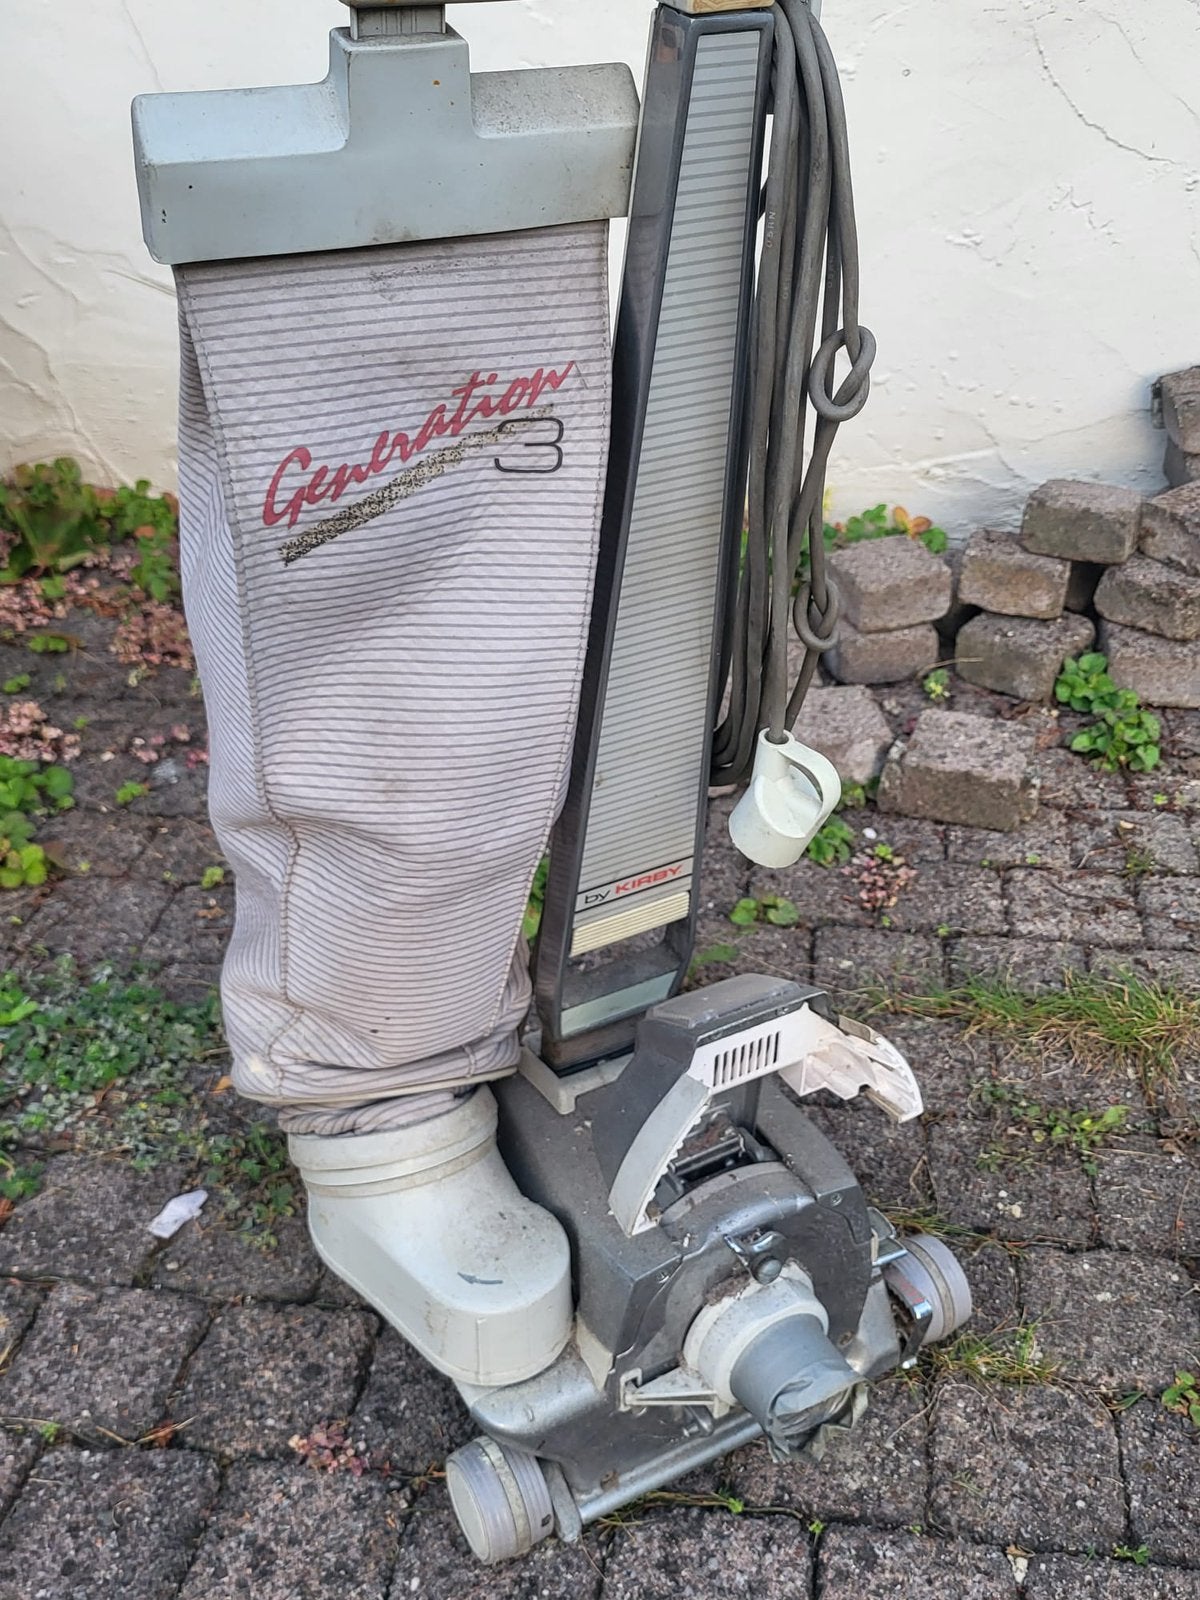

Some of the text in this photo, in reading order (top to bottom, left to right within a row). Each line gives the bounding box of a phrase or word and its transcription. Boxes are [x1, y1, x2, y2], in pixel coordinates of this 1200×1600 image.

[262, 360, 576, 529] Generation
[494, 416, 564, 474] 3
[584, 864, 683, 904] by KIRBY
